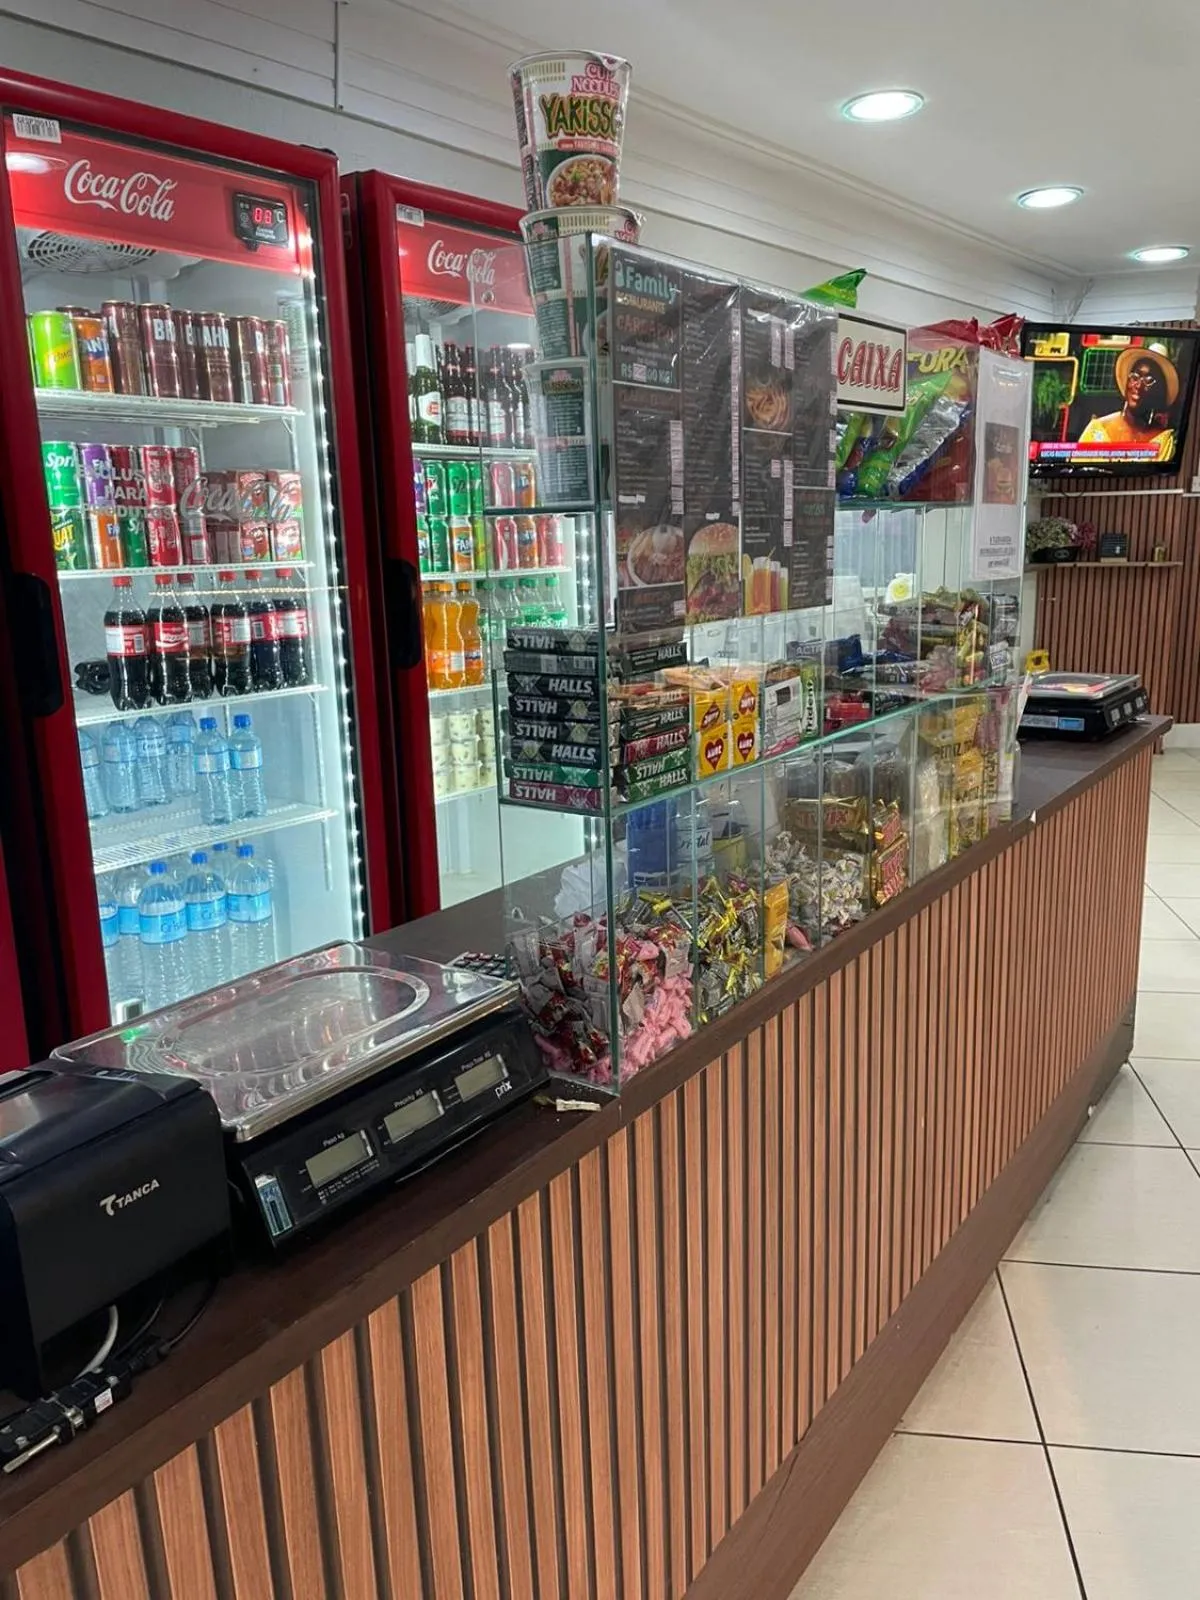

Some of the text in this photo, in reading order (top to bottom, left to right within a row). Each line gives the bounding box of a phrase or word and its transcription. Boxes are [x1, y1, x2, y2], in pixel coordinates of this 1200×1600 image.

[64, 158, 178, 222] Coca-Cola
[427, 240, 497, 285] Coca-Cola
[624, 265, 677, 306] Family
[837, 336, 903, 392] CAIXA
[658, 645, 682, 661] HALLS
[549, 678, 594, 696] HALLS
[515, 698, 557, 714] HALLS
[660, 709, 686, 725] HALLS
[516, 722, 557, 740] HALLS
[656, 730, 686, 750] HALLS
[551, 744, 596, 764] HALLS
[512, 765, 553, 781] HALLS
[659, 768, 688, 788] HALLS
[515, 784, 556, 802] HALLS
[494, 1081, 513, 1100] prix
[116, 1178, 160, 1210] TANCA
